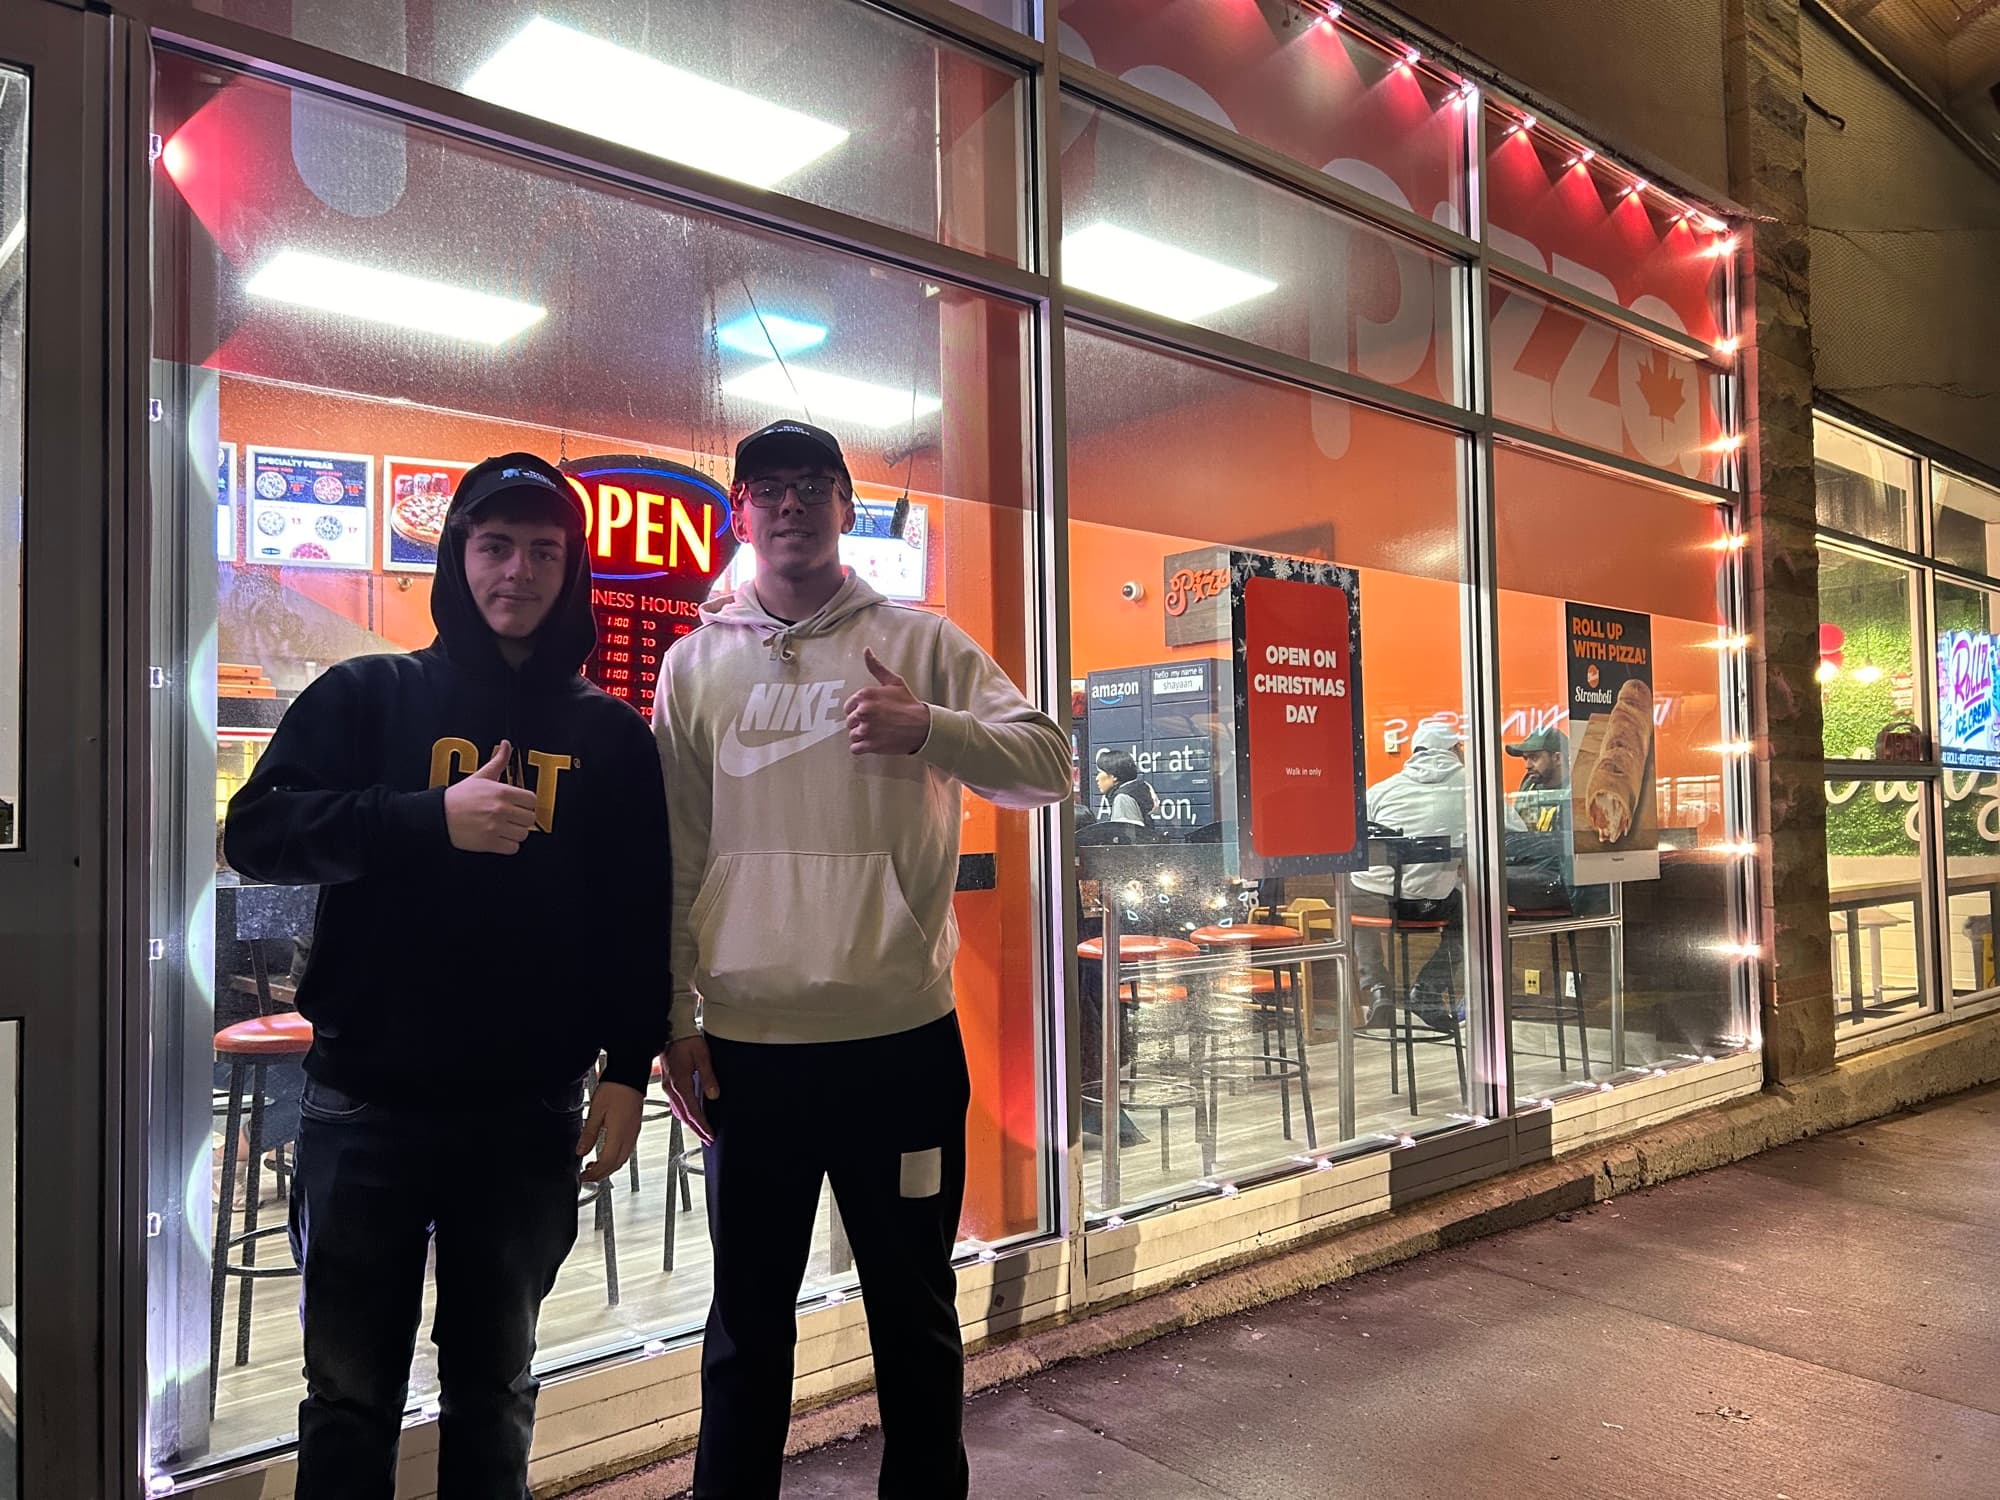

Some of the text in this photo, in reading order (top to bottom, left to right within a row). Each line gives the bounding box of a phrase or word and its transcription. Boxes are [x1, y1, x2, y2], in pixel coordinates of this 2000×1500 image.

[591, 588, 698, 617] INESS HOURS
[641, 620, 656, 630] TO
[1572, 617, 1623, 640] ROLL UP
[641, 638, 656, 647] TO
[641, 655, 656, 664] TO
[1266, 645, 1336, 668] OPEN ON
[1573, 640, 1646, 664] WITH PIZZA!
[641, 672, 655, 681] TO
[1154, 670, 1169, 680] hello
[1171, 670, 1180, 678] my
[1180, 668, 1197, 676] name
[640, 689, 655, 698] TO
[1092, 681, 1139, 698] amazon
[1254, 674, 1345, 697] CHRISTMAS
[1575, 685, 1612, 704] Stromboli
[640, 706, 654, 716] TO
[740, 680, 846, 731] NIKE
[1286, 704, 1318, 723] DAY
[1169, 745, 1194, 772] at
[1286, 767, 1322, 777] Walk in only
